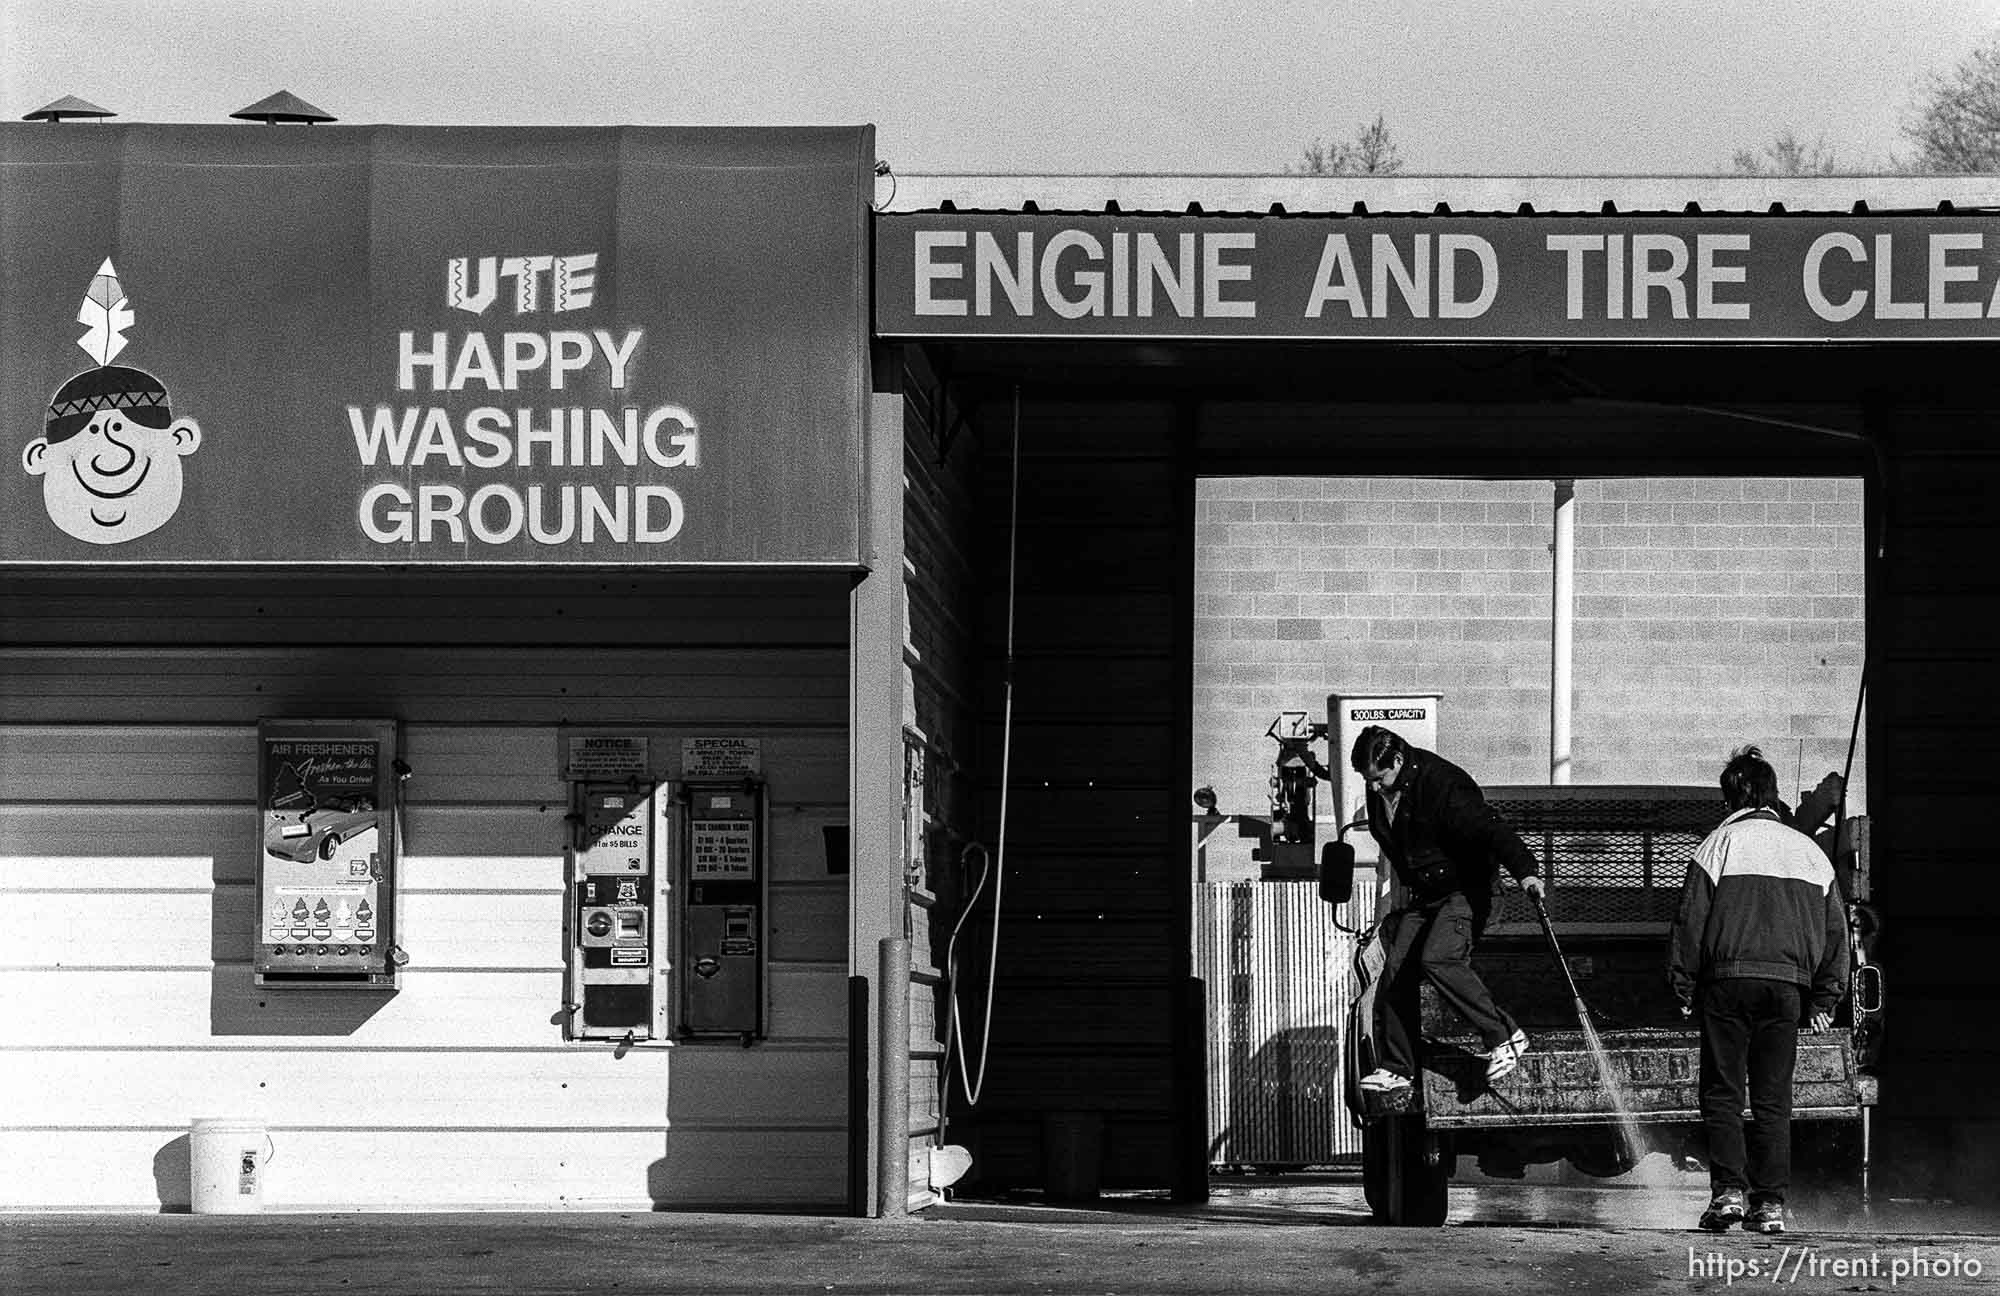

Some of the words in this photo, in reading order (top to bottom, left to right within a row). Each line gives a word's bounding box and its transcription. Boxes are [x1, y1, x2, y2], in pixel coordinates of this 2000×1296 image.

[914, 229, 1256, 319] ENGINE
[1305, 233, 1499, 319] AND
[1546, 233, 1751, 320] TIRE
[1802, 231, 2000, 322] CLE
[449, 253, 598, 316] UTE
[399, 330, 643, 391] HAPPY
[348, 405, 698, 468] WASHING
[358, 483, 684, 544] GROUND
[1388, 710, 1425, 719] CAPACITY
[585, 739, 633, 748] NOTICE
[695, 739, 746, 748] SPECIAL
[272, 744, 290, 755] AIR
[295, 744, 375, 756] FRESHENERS
[332, 775, 347, 783] You
[590, 825, 642, 836] CHANGE
[609, 840, 619, 848] $5
[619, 840, 639, 848] BILLS
